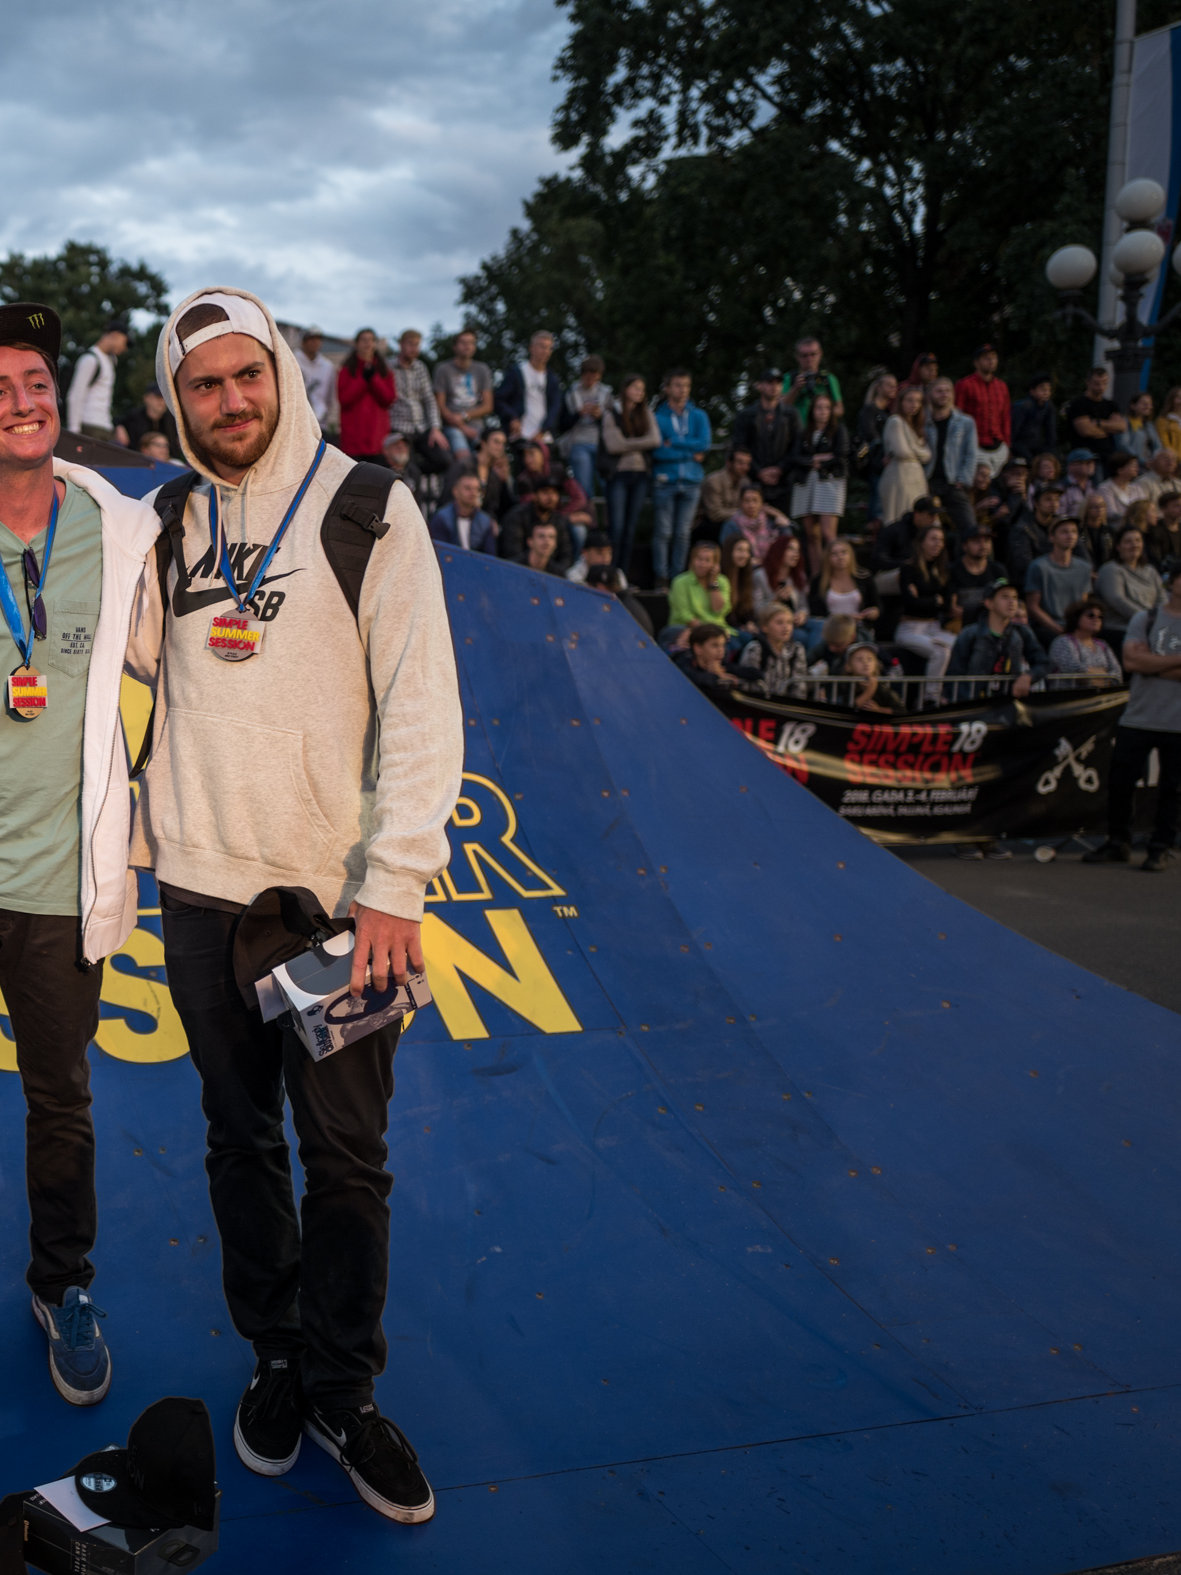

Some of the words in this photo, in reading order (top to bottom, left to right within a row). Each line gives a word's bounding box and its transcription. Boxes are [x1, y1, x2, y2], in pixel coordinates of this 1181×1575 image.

[248, 590, 286, 622] SB
[212, 617, 249, 630] SIMPLE
[210, 627, 260, 642] SUMMER
[208, 637, 255, 651] SESSION
[12, 676, 38, 687] SIMPLE
[12, 687, 48, 697] SUMMER
[13, 697, 46, 707] SESSION
[776, 721, 817, 753] 18
[846, 722, 954, 753] SIMPLE
[950, 720, 989, 753] 18
[844, 752, 975, 784] SESSION
[553, 906, 578, 917] TM
